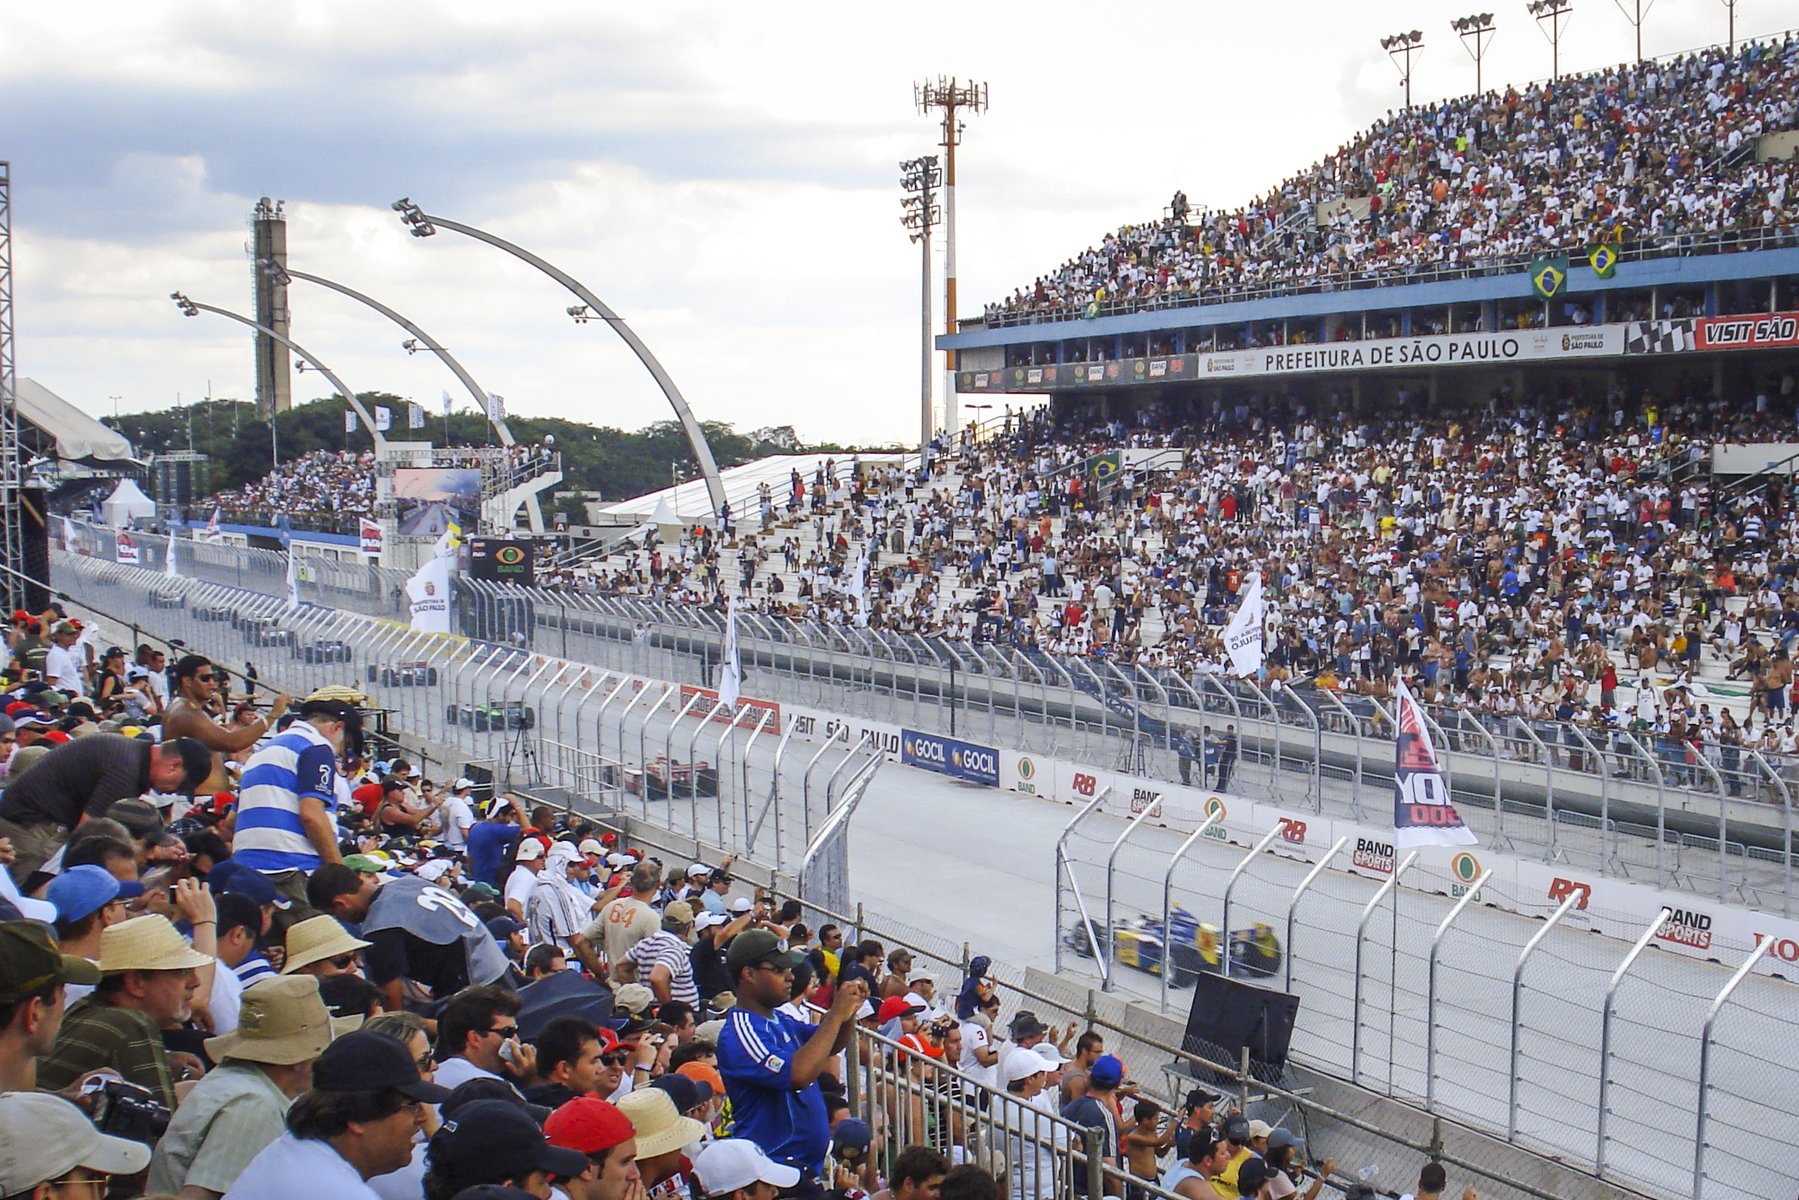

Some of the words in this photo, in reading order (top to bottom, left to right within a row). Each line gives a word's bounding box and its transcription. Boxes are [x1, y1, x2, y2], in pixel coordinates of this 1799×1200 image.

[1705, 321, 1754, 345] VISIT
[1754, 316, 1797, 342] SÃO
[1265, 349, 1364, 371] PREFEITURA
[1371, 346, 1393, 364] DE
[1400, 340, 1442, 363] SÃO
[1449, 338, 1519, 361] PAULO
[1584, 341, 1604, 349] PAULO
[497, 565, 524, 573] BAND
[915, 738, 946, 762] GOCIL
[963, 749, 997, 775] GOCIL
[1017, 781, 1036, 794] BAND
[1356, 838, 1394, 858] BAND
[1354, 851, 1394, 873] SPORTS
[608, 902, 637, 928] 64
[1656, 922, 1711, 949] SPORTS
[977, 1030, 984, 1041] 3
